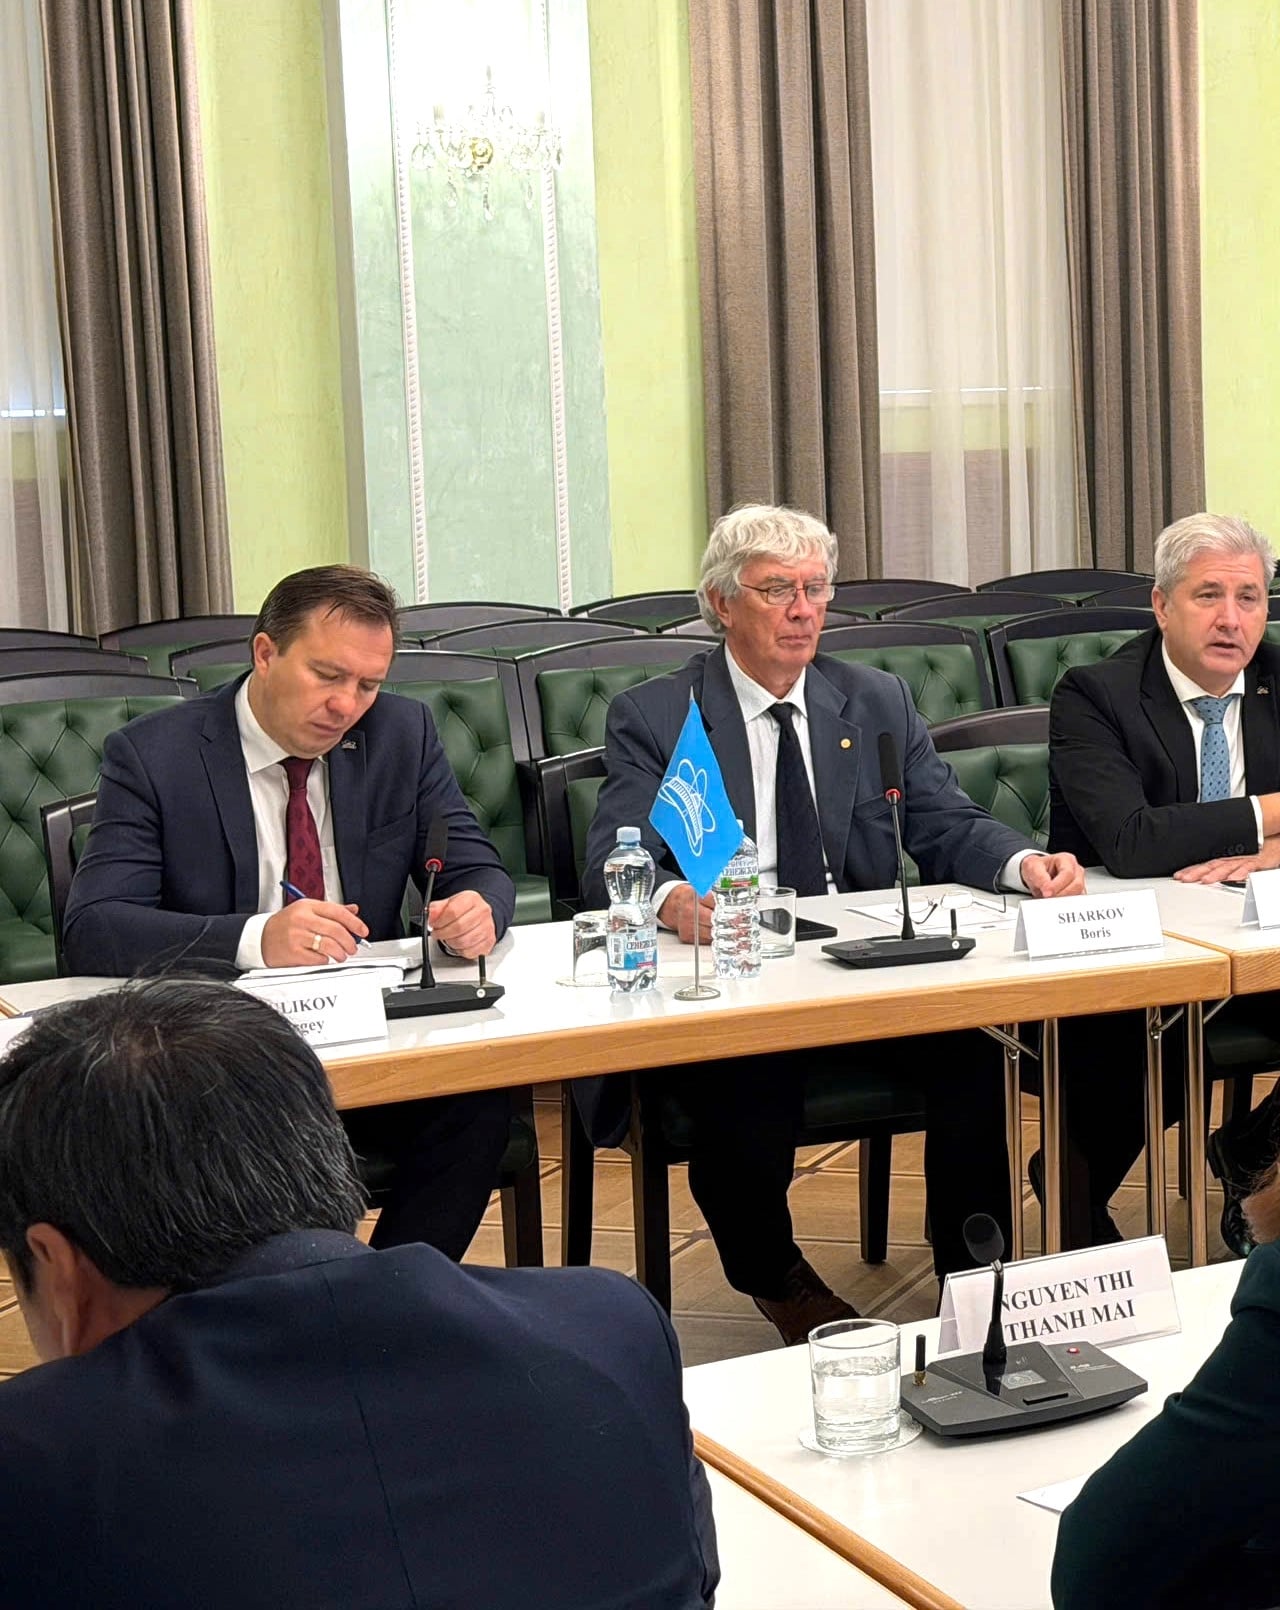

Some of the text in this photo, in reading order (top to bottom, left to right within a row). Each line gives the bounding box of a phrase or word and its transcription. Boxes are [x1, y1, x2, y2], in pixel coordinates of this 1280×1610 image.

[1057, 906, 1125, 924] SHARKOV
[1080, 926, 1112, 940] Boris
[274, 994, 338, 1014] LIKOV
[1001, 1269, 1135, 1312] NGUYEN THI
[1004, 1299, 1137, 1342] THANH MAI
